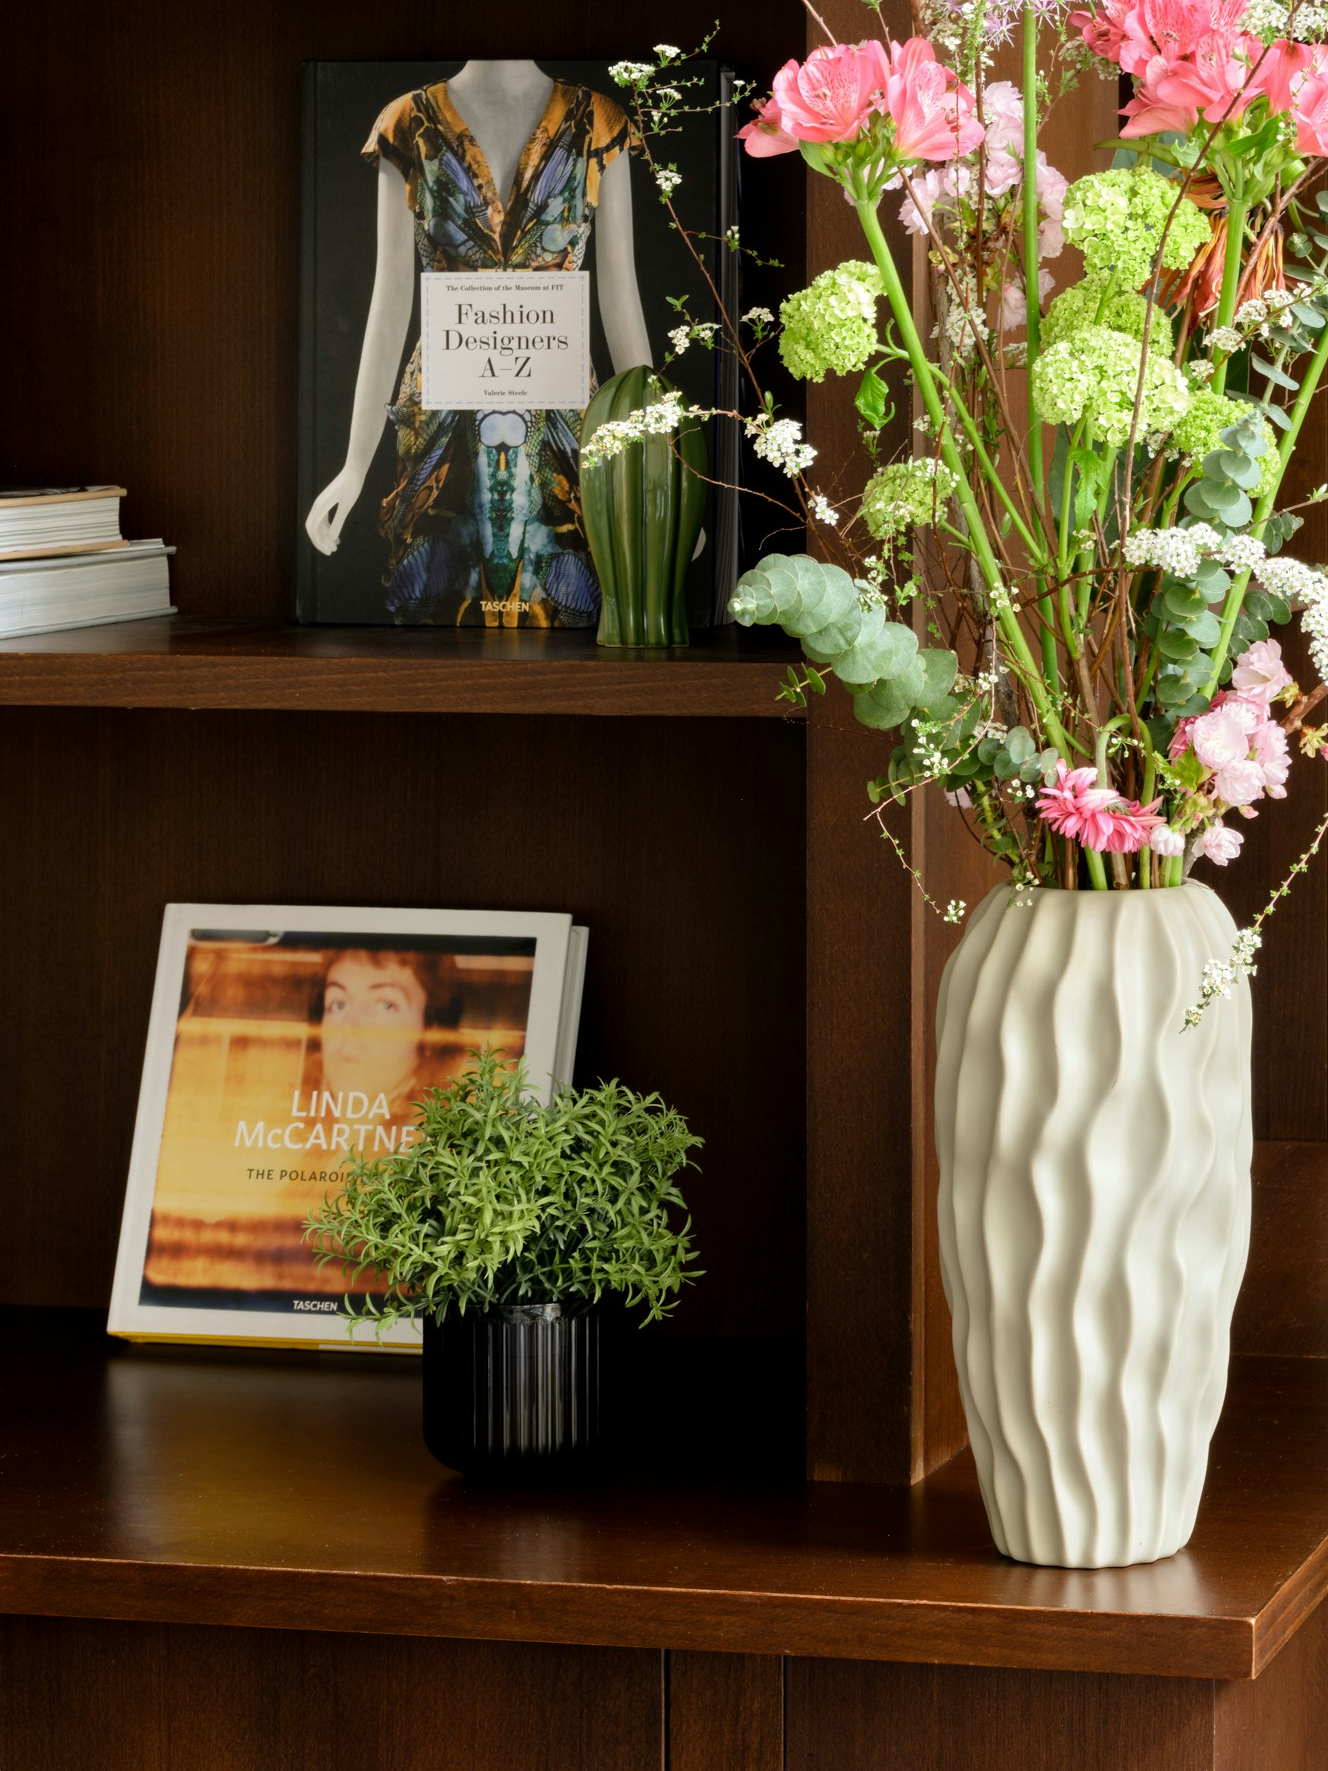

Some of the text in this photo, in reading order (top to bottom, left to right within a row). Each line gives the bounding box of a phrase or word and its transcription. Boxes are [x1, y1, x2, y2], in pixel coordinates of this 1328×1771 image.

[460, 284, 492, 292] Collection
[454, 303, 556, 324] Fashion
[442, 330, 568, 356] Designers
[480, 601, 530, 612] TASCHEN
[292, 1090, 390, 1120] LINDA
[234, 1120, 422, 1154] McCARTNE
[247, 1168, 274, 1180] THE
[293, 1300, 338, 1312] TASCHEN
